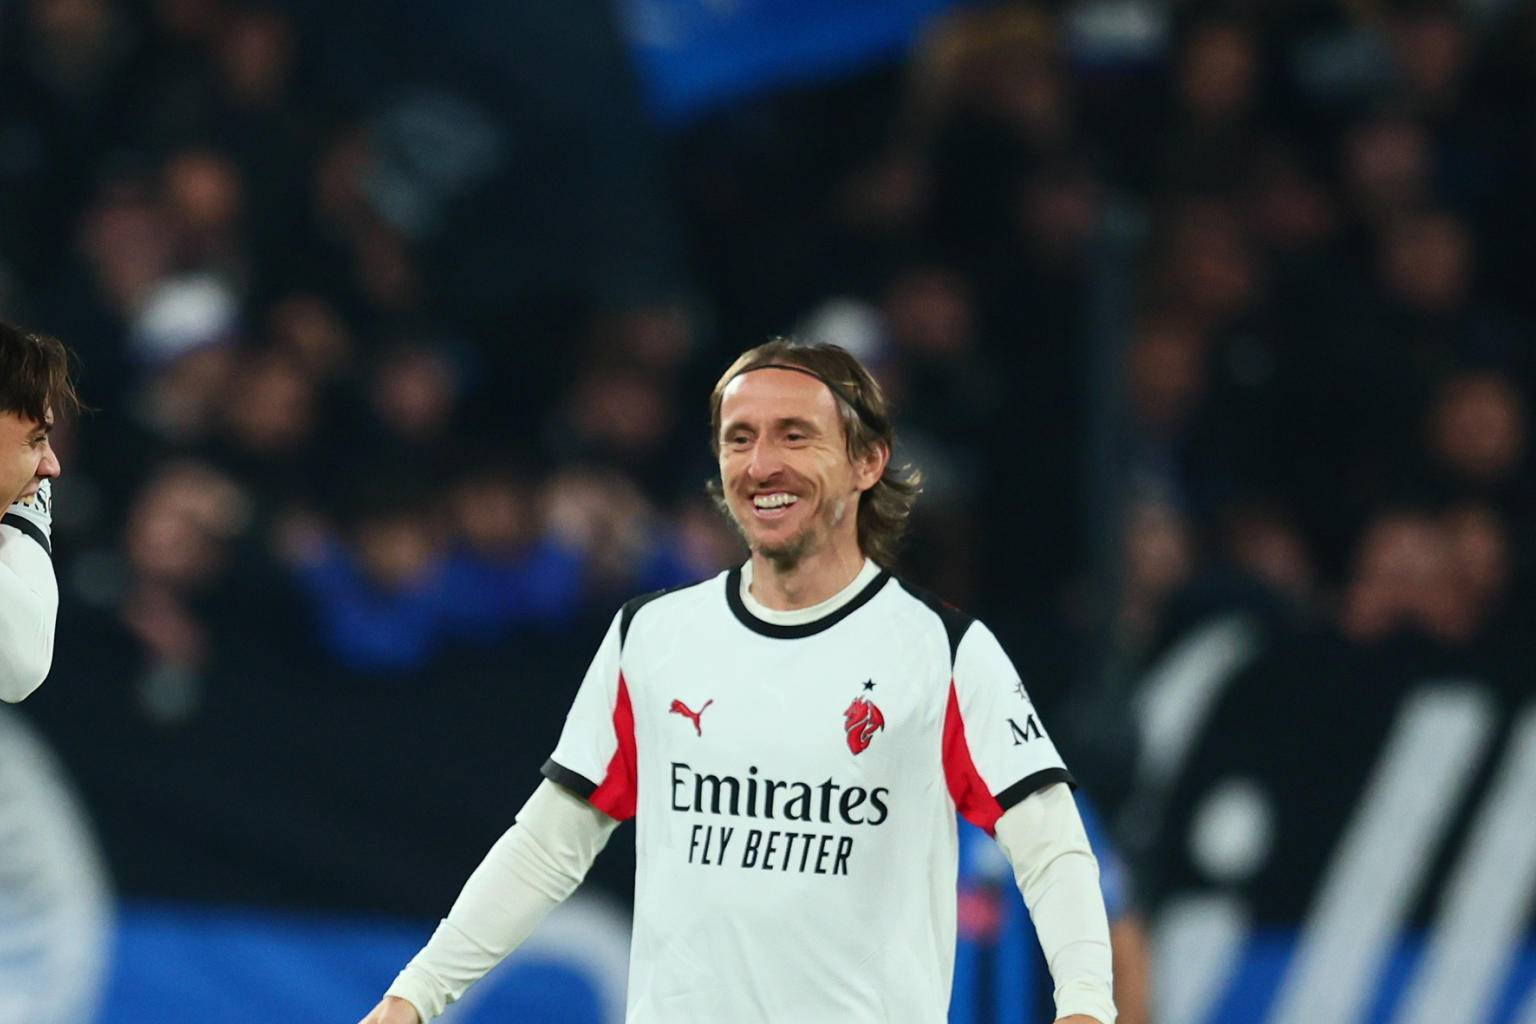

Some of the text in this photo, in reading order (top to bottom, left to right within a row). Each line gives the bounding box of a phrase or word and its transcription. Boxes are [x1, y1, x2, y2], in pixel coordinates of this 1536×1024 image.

[671, 761, 890, 826] Emirates
[688, 824, 854, 876] FLY BETTER
